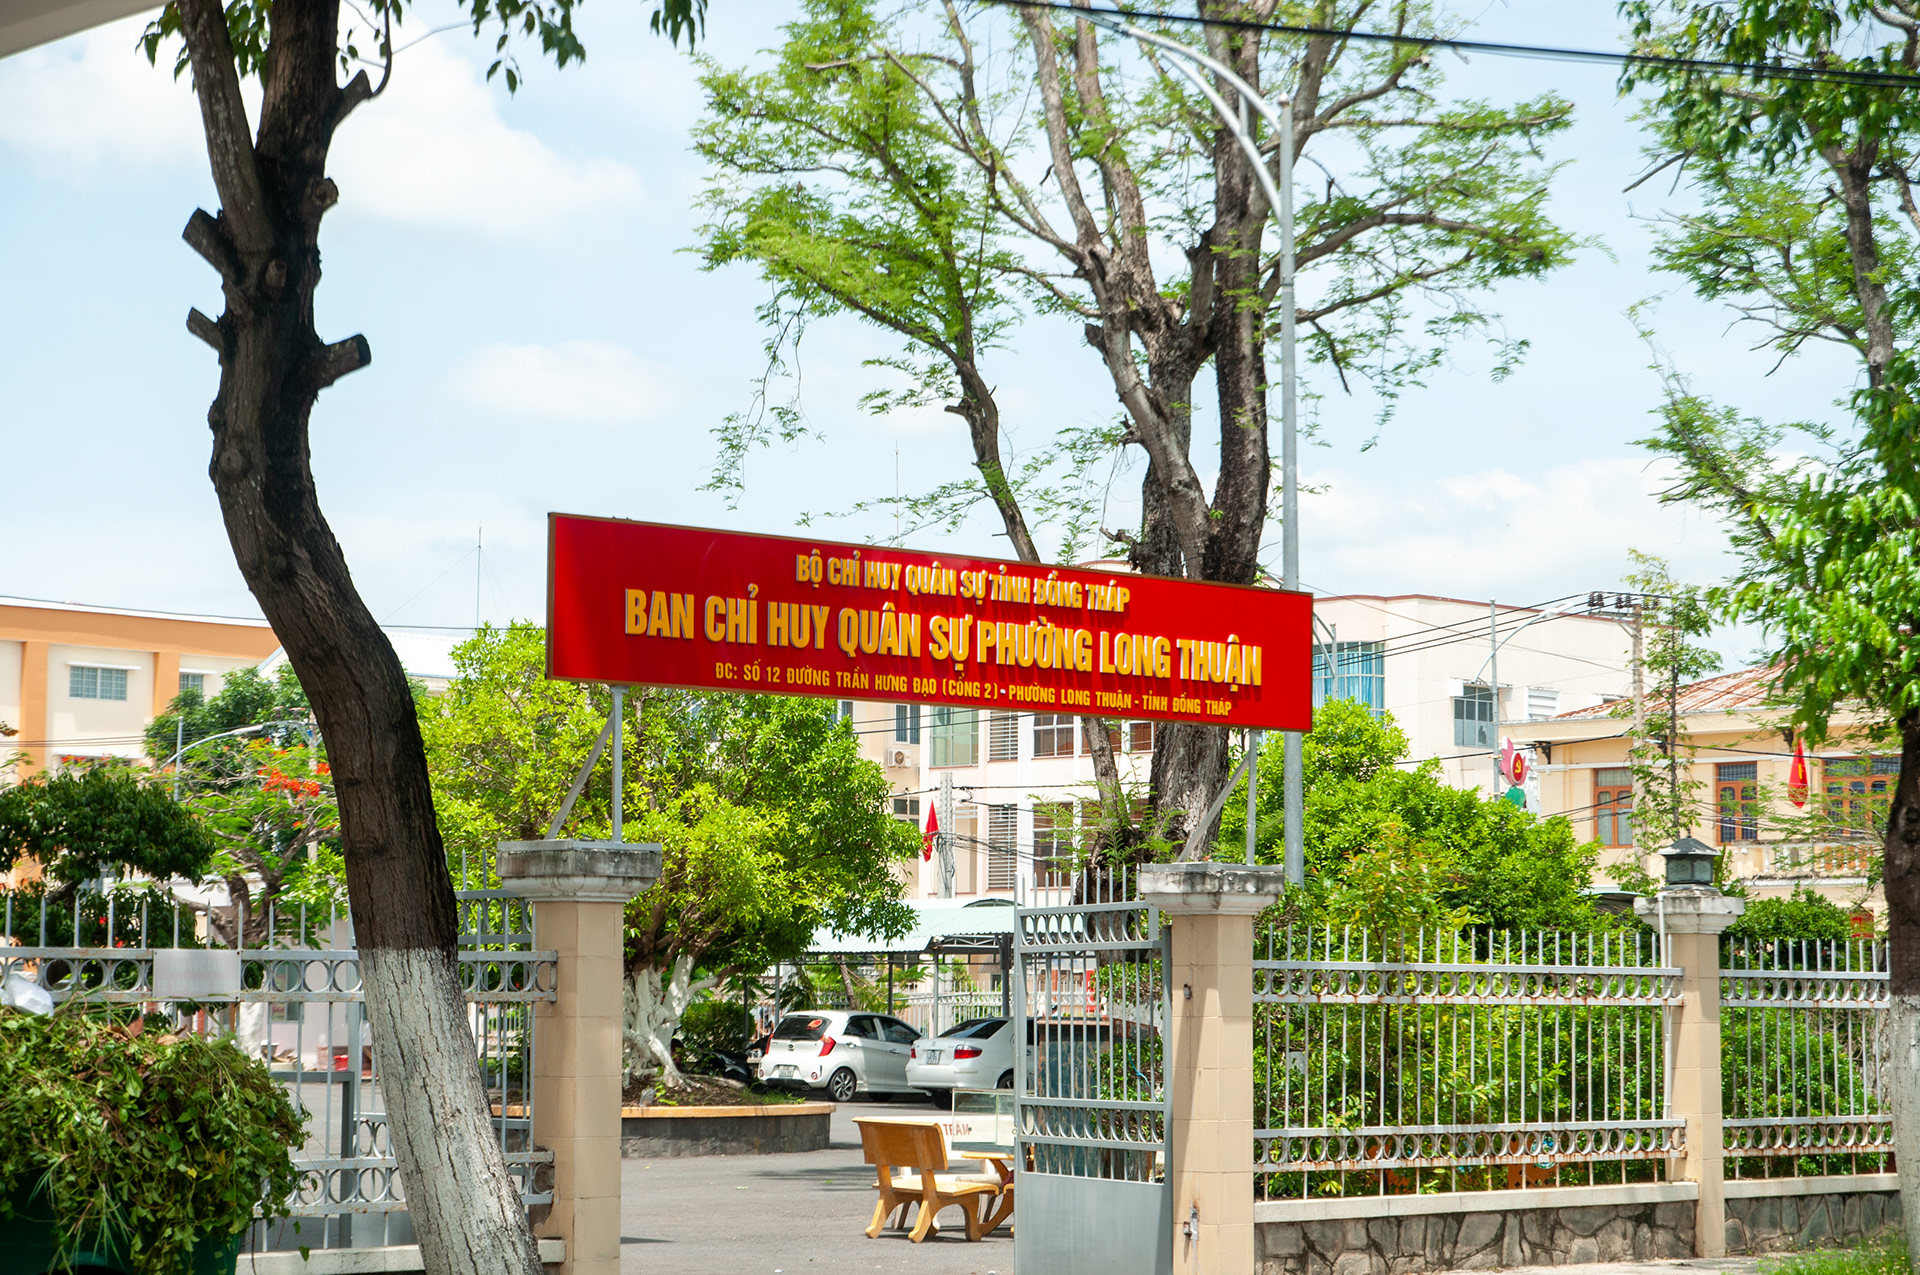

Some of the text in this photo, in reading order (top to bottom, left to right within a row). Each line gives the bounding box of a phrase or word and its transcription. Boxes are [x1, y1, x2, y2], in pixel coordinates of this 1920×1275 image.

[796, 548, 1130, 612] BỘ CHỈ HUY QUÂN SỰ TỈNH ĐỒNG THÁP
[625, 583, 1262, 692] BAN CHỈ HUY QUÂN SỰ PHƯỜNG LONG THUẬN
[715, 662, 738, 680] ĐC:
[743, 658, 761, 682] SỐ
[766, 666, 781, 683] 12
[786, 665, 830, 687] ĐƯỜNG
[836, 666, 869, 690] TRẦN
[874, 674, 908, 693] HƯNG
[912, 677, 937, 697] ĐẠO
[942, 672, 981, 698] (CỔNG
[1008, 682, 1056, 704] PHƯỜNG
[1061, 688, 1091, 706] LONG
[1095, 689, 1132, 711] THUẬN
[1142, 690, 1168, 712] TỈNH
[1172, 692, 1201, 714] ĐỒNG
[1205, 697, 1232, 716] THÁP
